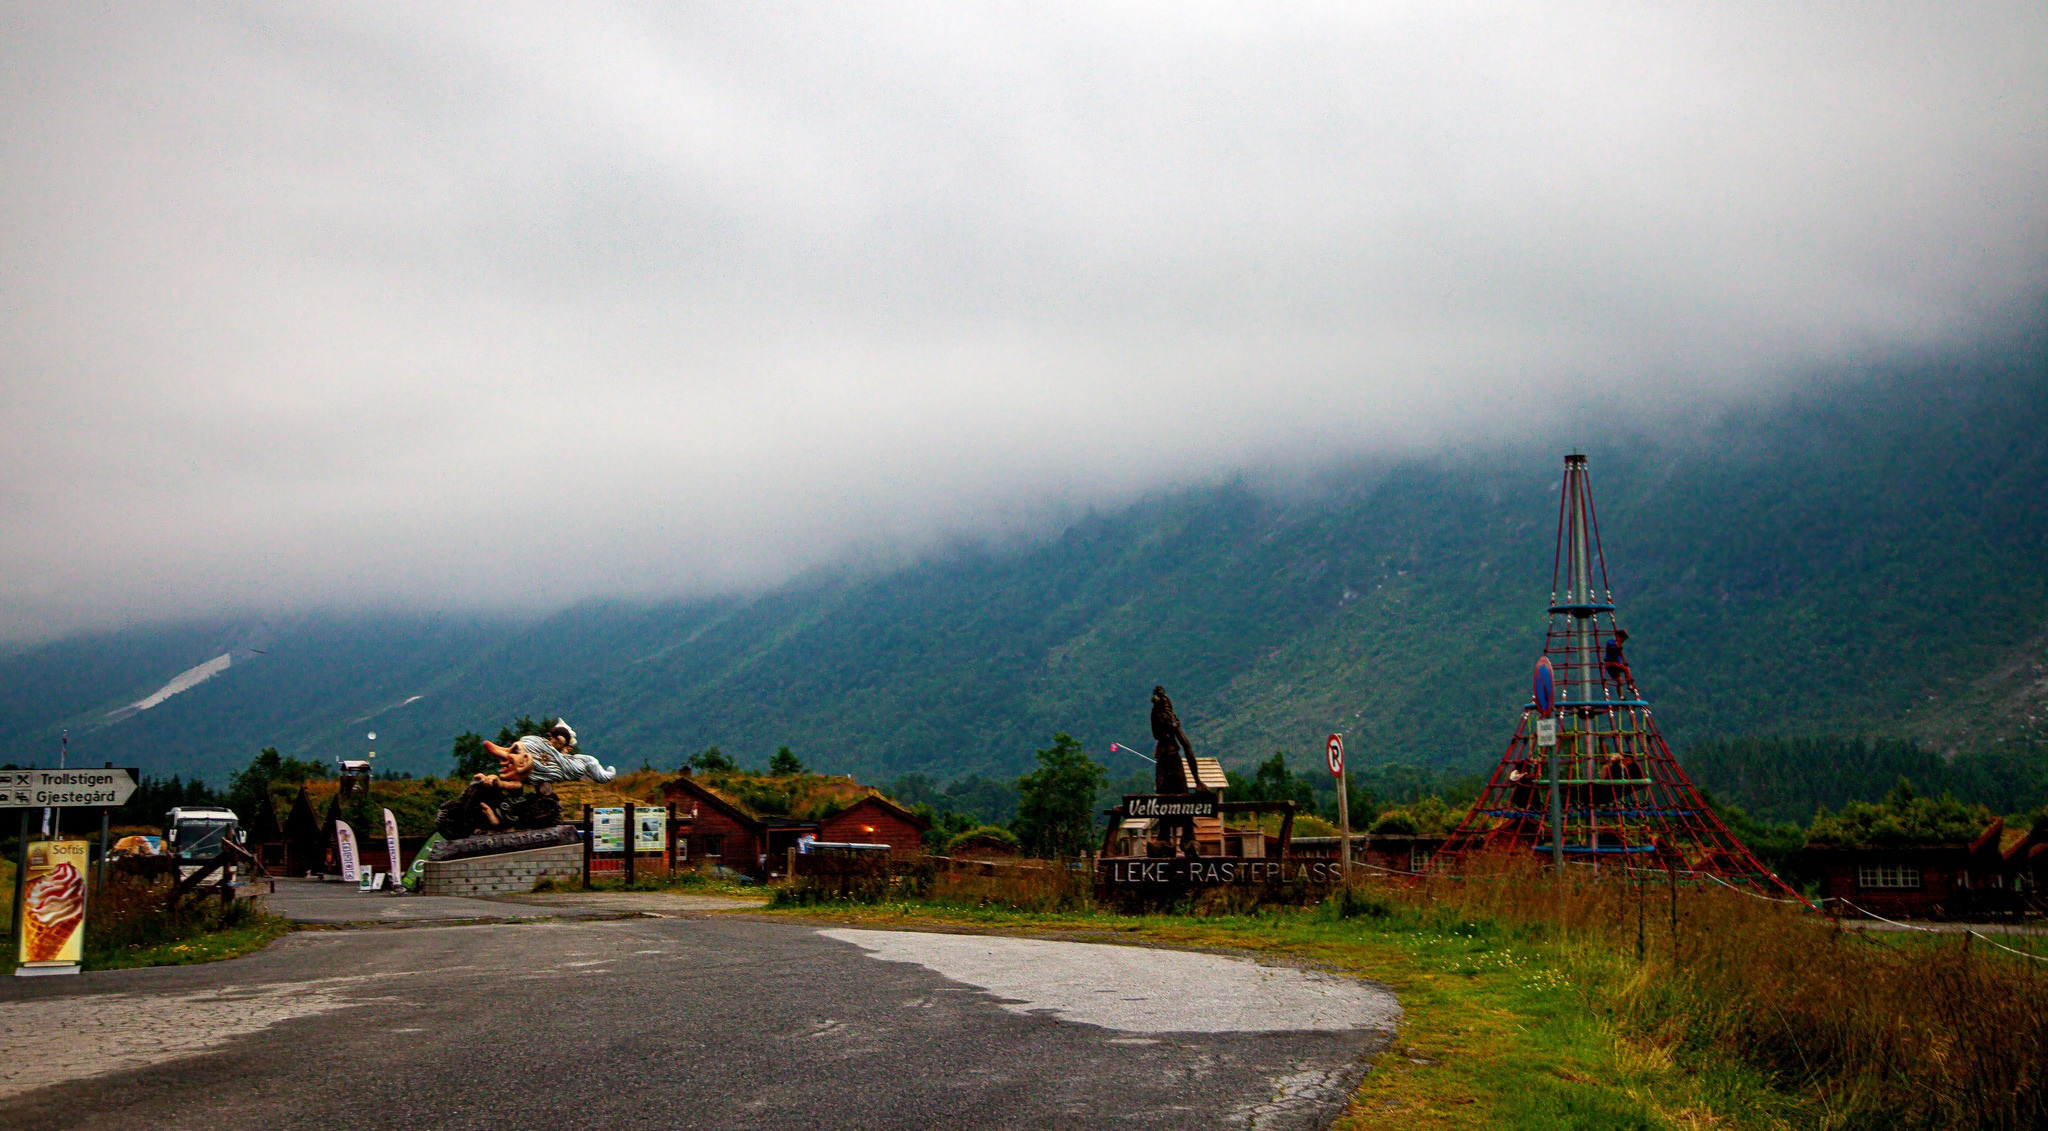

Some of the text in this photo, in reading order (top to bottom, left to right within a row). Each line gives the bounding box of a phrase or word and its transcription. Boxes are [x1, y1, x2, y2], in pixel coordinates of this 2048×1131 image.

[41, 773, 114, 787] Trollstigen
[36, 790, 116, 805] Gjestegård
[1128, 798, 1213, 816] Velkommen
[53, 844, 84, 855] Softis
[1114, 862, 1169, 882] LEKE
[1189, 861, 1343, 884] RASTEPLASS
